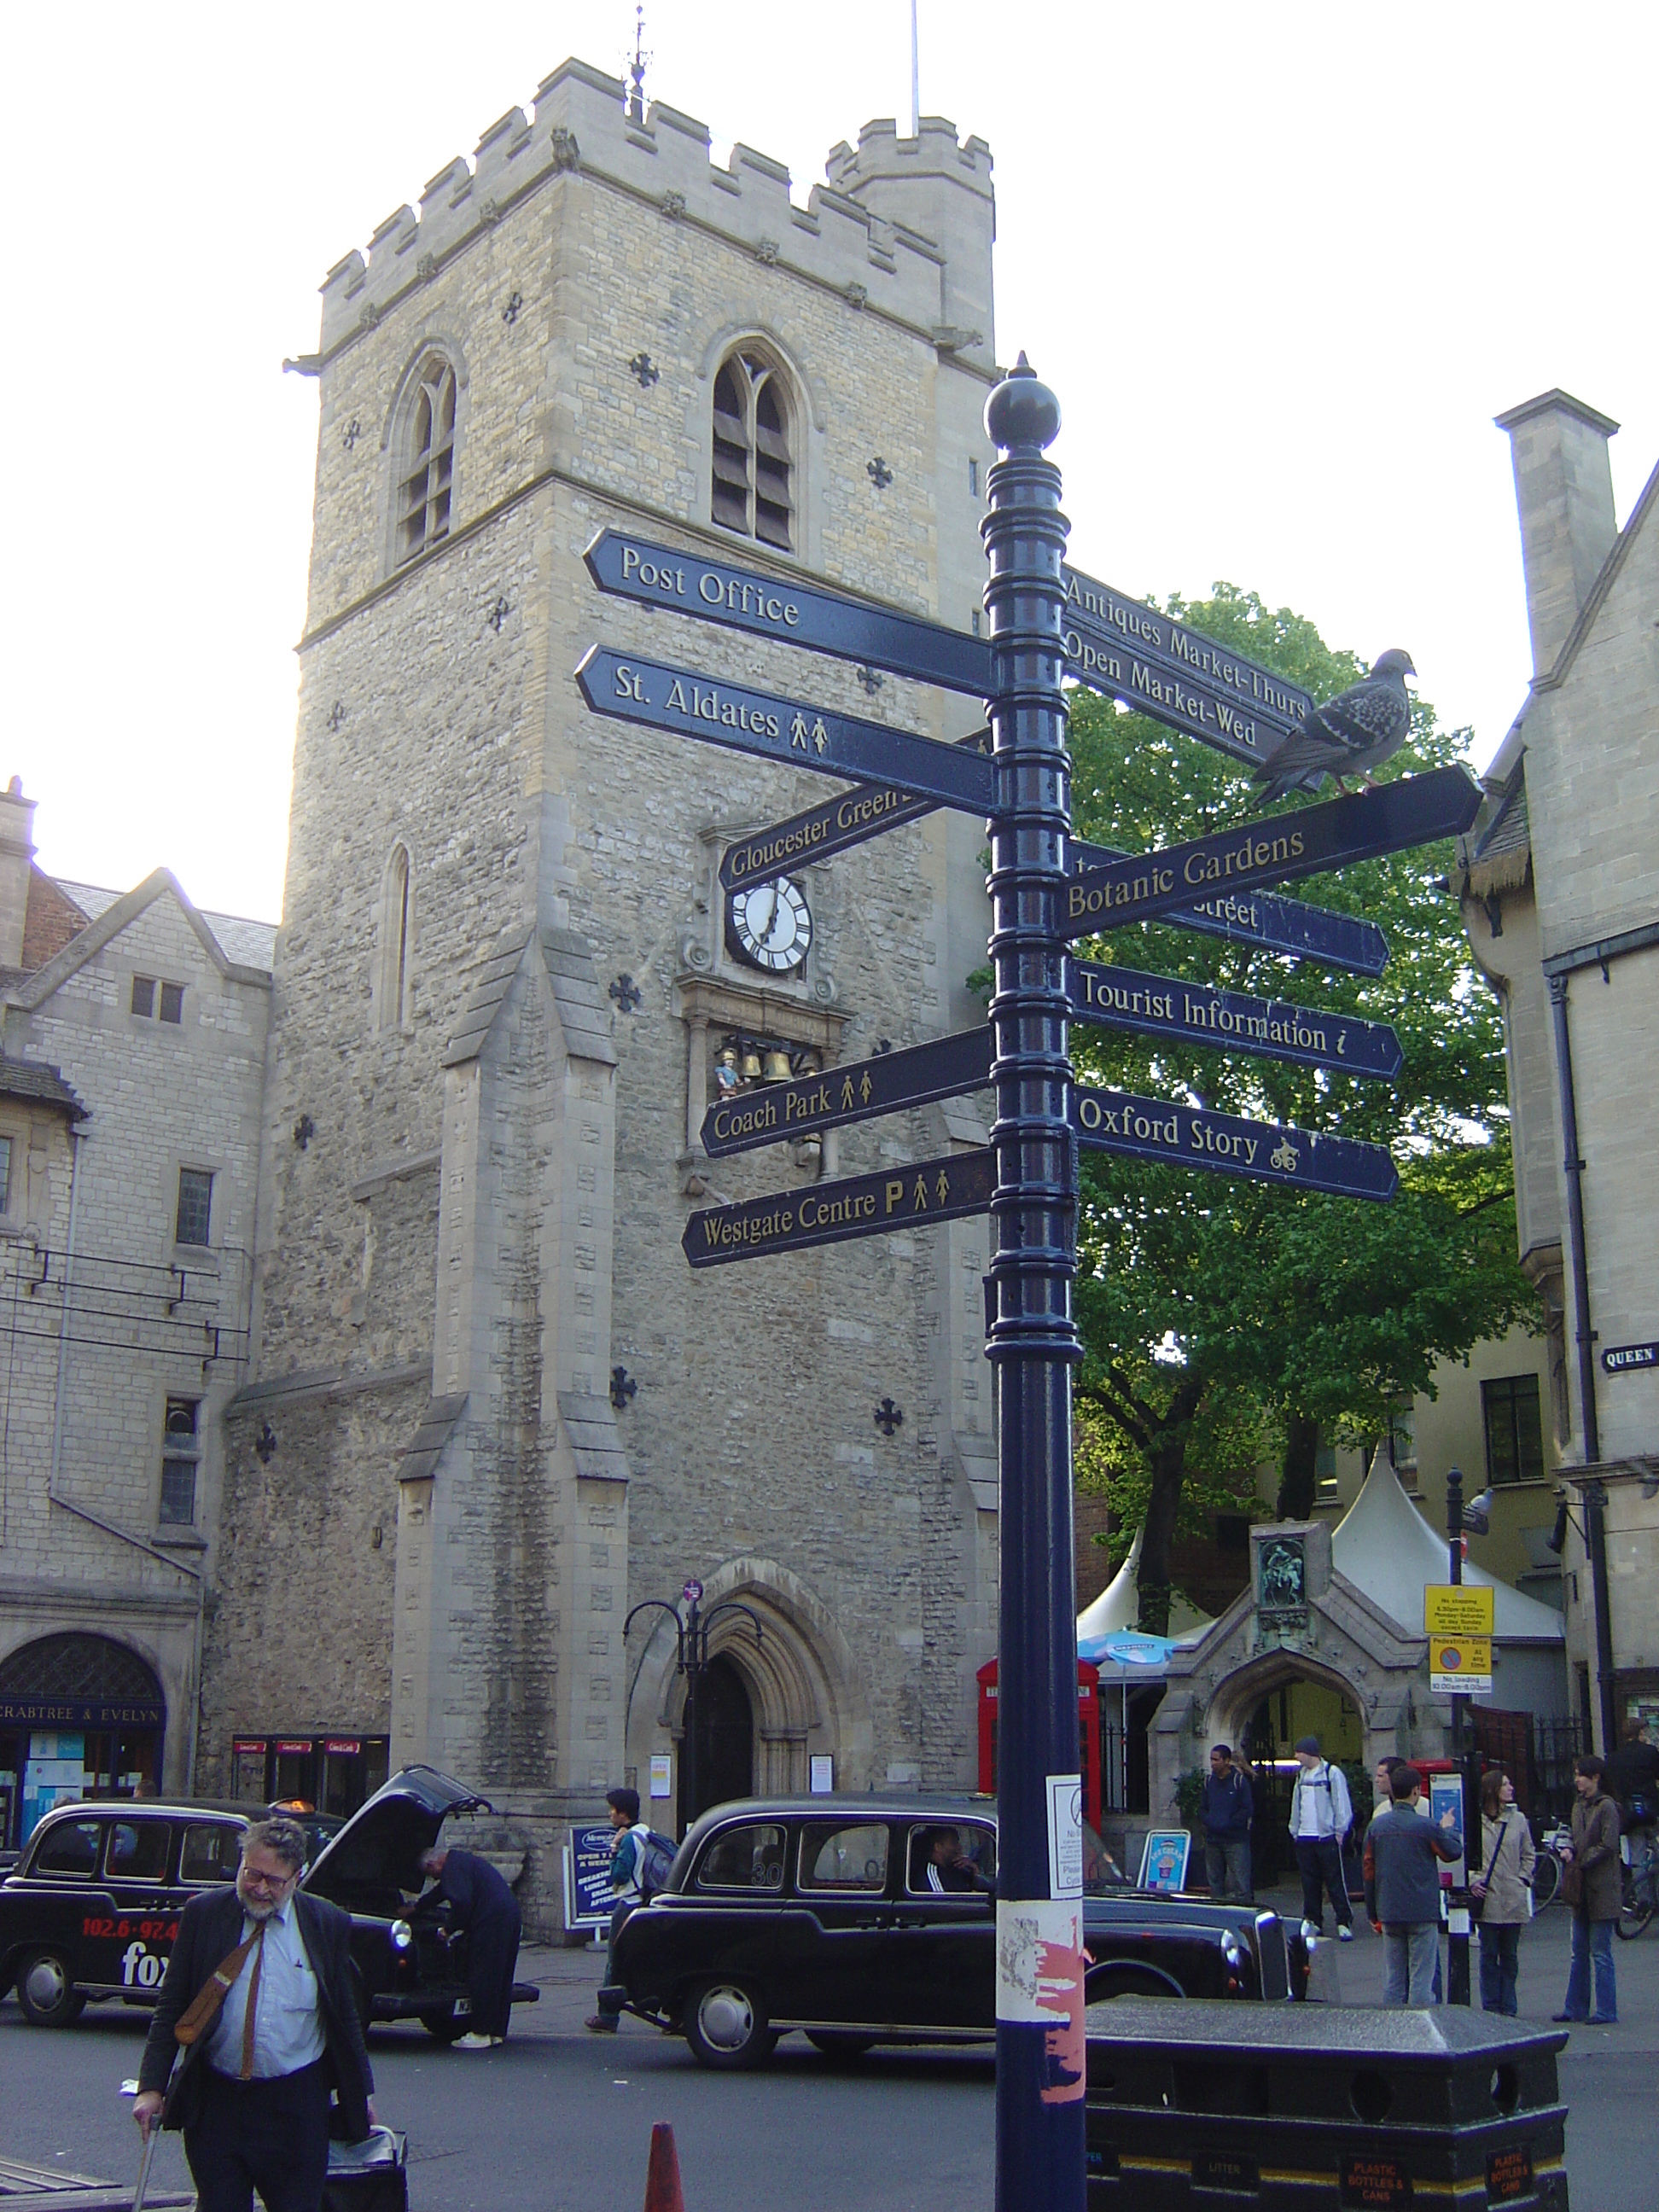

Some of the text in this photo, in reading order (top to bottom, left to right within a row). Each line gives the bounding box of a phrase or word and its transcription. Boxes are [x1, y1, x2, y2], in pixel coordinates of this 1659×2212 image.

[620, 547, 799, 626] Post Office
[1066, 575, 1306, 719] Antiques Market-Thurs
[614, 666, 779, 737] St. Aldates
[1066, 632, 1256, 747] Open Market-Wed
[731, 790, 898, 876] Gloucester Green
[1069, 830, 1305, 917] Botanic Gardens
[1080, 970, 1174, 1020] Tourist
[1185, 994, 1327, 1051] Information
[714, 1085, 832, 1139] Coach Park
[1080, 1098, 1259, 1165] Oxford Story
[703, 1179, 904, 1247] Westgate Centre P
[1606, 1348, 1653, 1367] QUEEN
[84, 1709, 91, 1720] &
[102, 1708, 160, 1721] EVELYN
[83, 1918, 130, 1938] 102.6
[1208, 2163, 1241, 2174] LITTER
[1348, 2175, 1394, 2189] BOTTLES
[1353, 2162, 1396, 2176] PLASTIC
[1362, 2190, 1391, 2203] CANS
